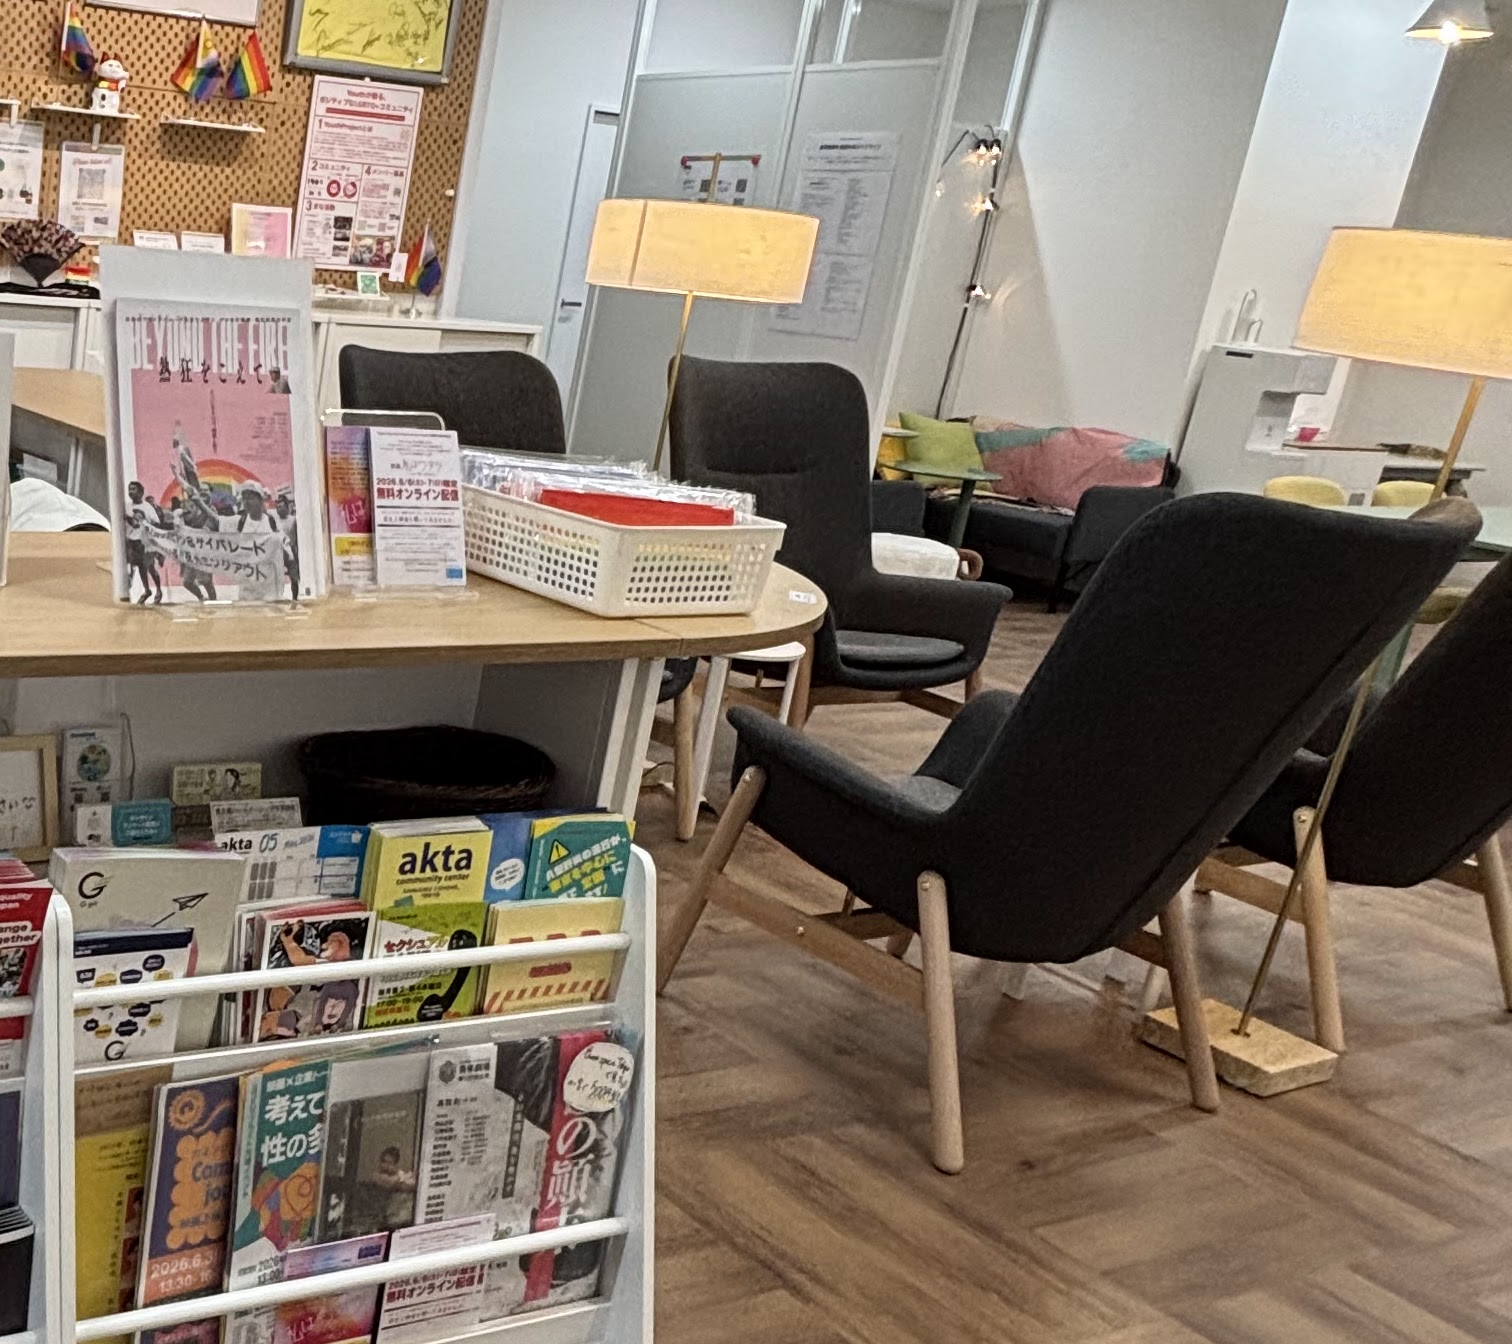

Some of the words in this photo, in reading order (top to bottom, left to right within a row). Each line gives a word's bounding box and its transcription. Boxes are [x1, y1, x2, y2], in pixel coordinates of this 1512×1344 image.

[311, 160, 318, 171] 2
[365, 166, 372, 176] 4
[306, 201, 312, 211] 3
[221, 837, 253, 851] akta
[399, 842, 473, 875] akta
[396, 875, 442, 885] community
[444, 873, 470, 882] center
[265, 1089, 325, 1126] 考えて
[386, 1274, 476, 1303] 無料オンライン配信
